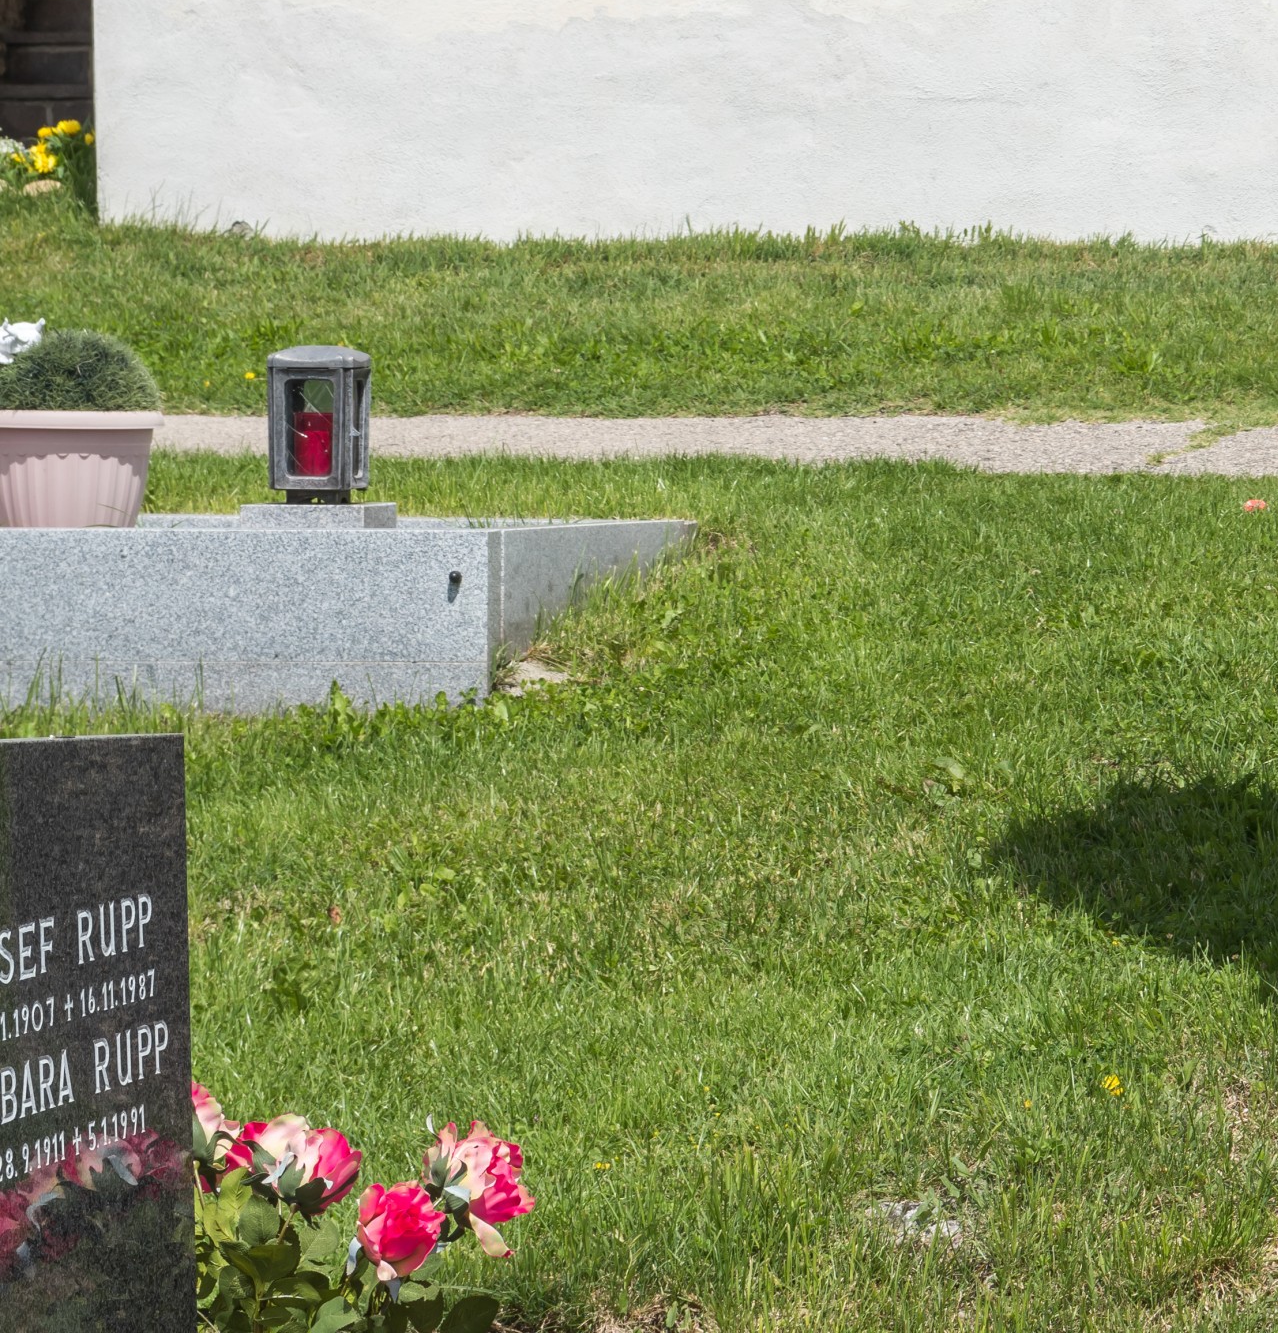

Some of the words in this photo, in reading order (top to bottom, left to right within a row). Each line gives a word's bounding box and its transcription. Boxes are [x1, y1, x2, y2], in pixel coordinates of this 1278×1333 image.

[76, 893, 153, 965] RUPP
[80, 969, 156, 1017] 16.11.1987
[0, 1049, 75, 1125] BARA
[93, 1019, 169, 1094] RUPP
